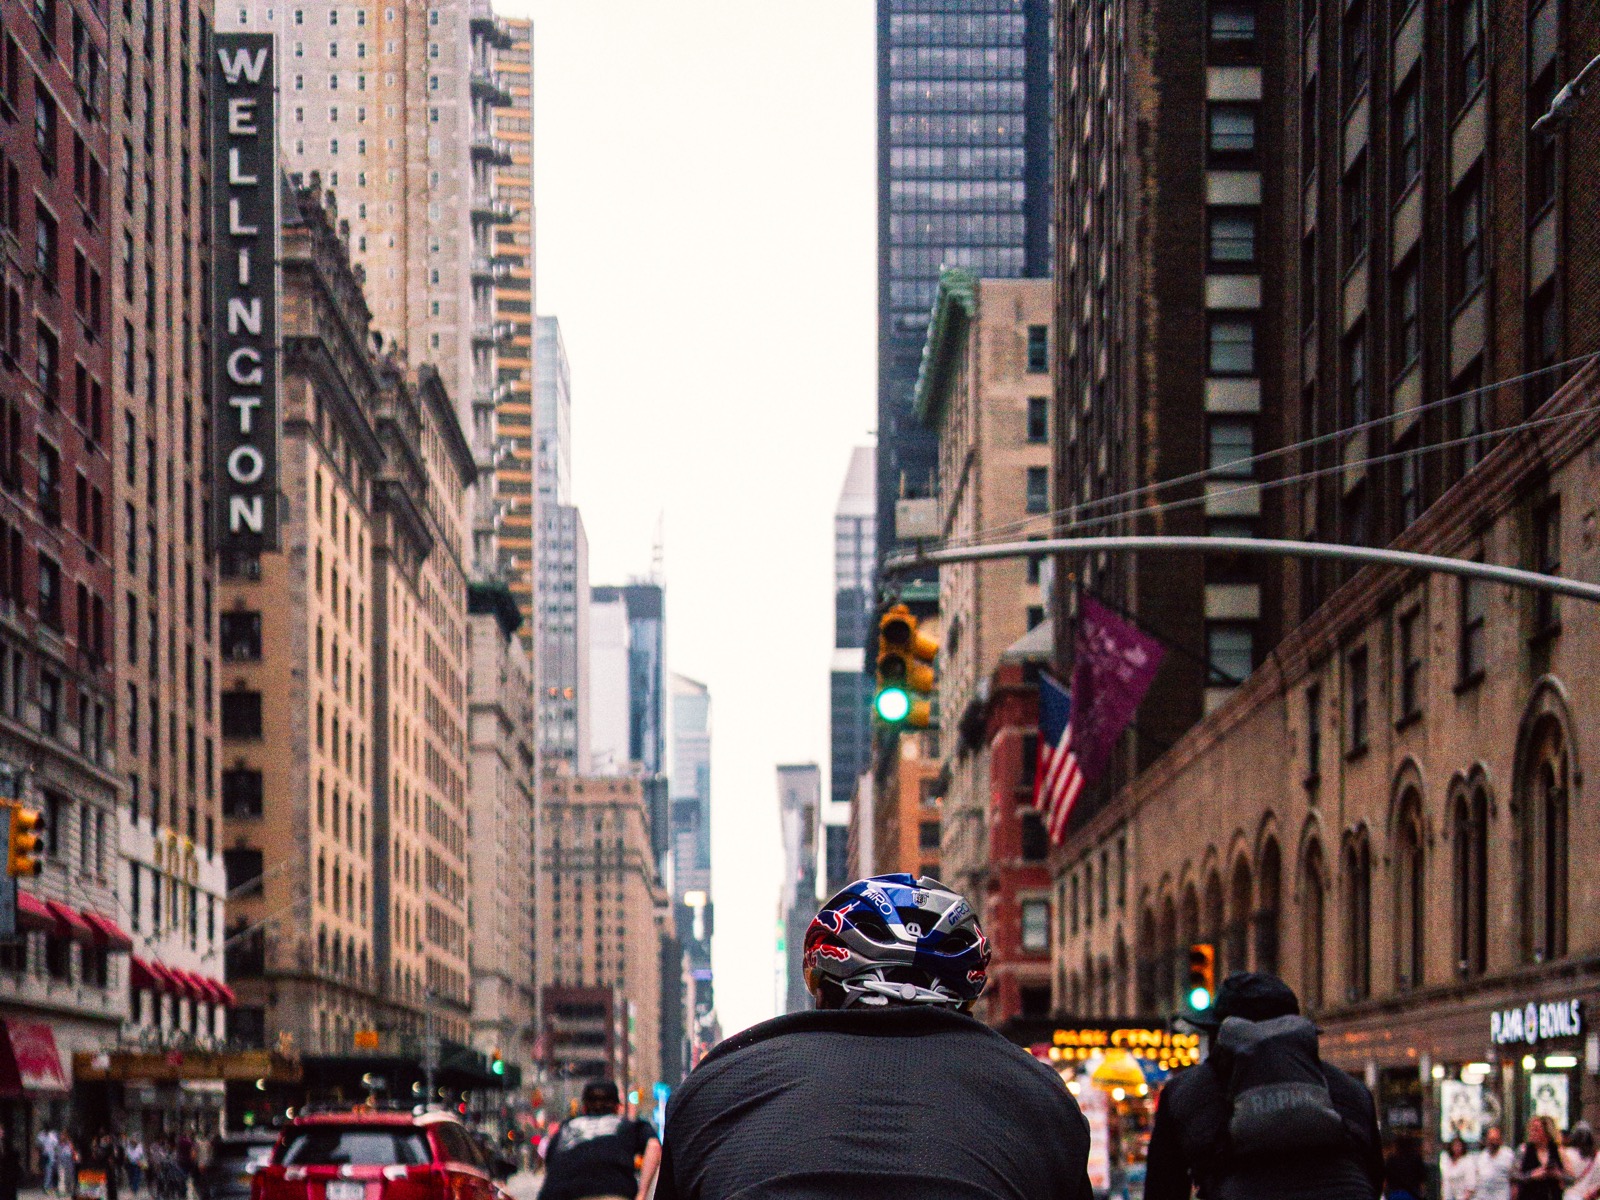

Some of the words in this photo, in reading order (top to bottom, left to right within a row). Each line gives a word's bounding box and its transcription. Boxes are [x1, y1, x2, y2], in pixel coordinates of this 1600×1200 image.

[218, 49, 267, 532] WELLINGTON
[860, 889, 893, 915] GIRO
[948, 902, 970, 926] GIRO
